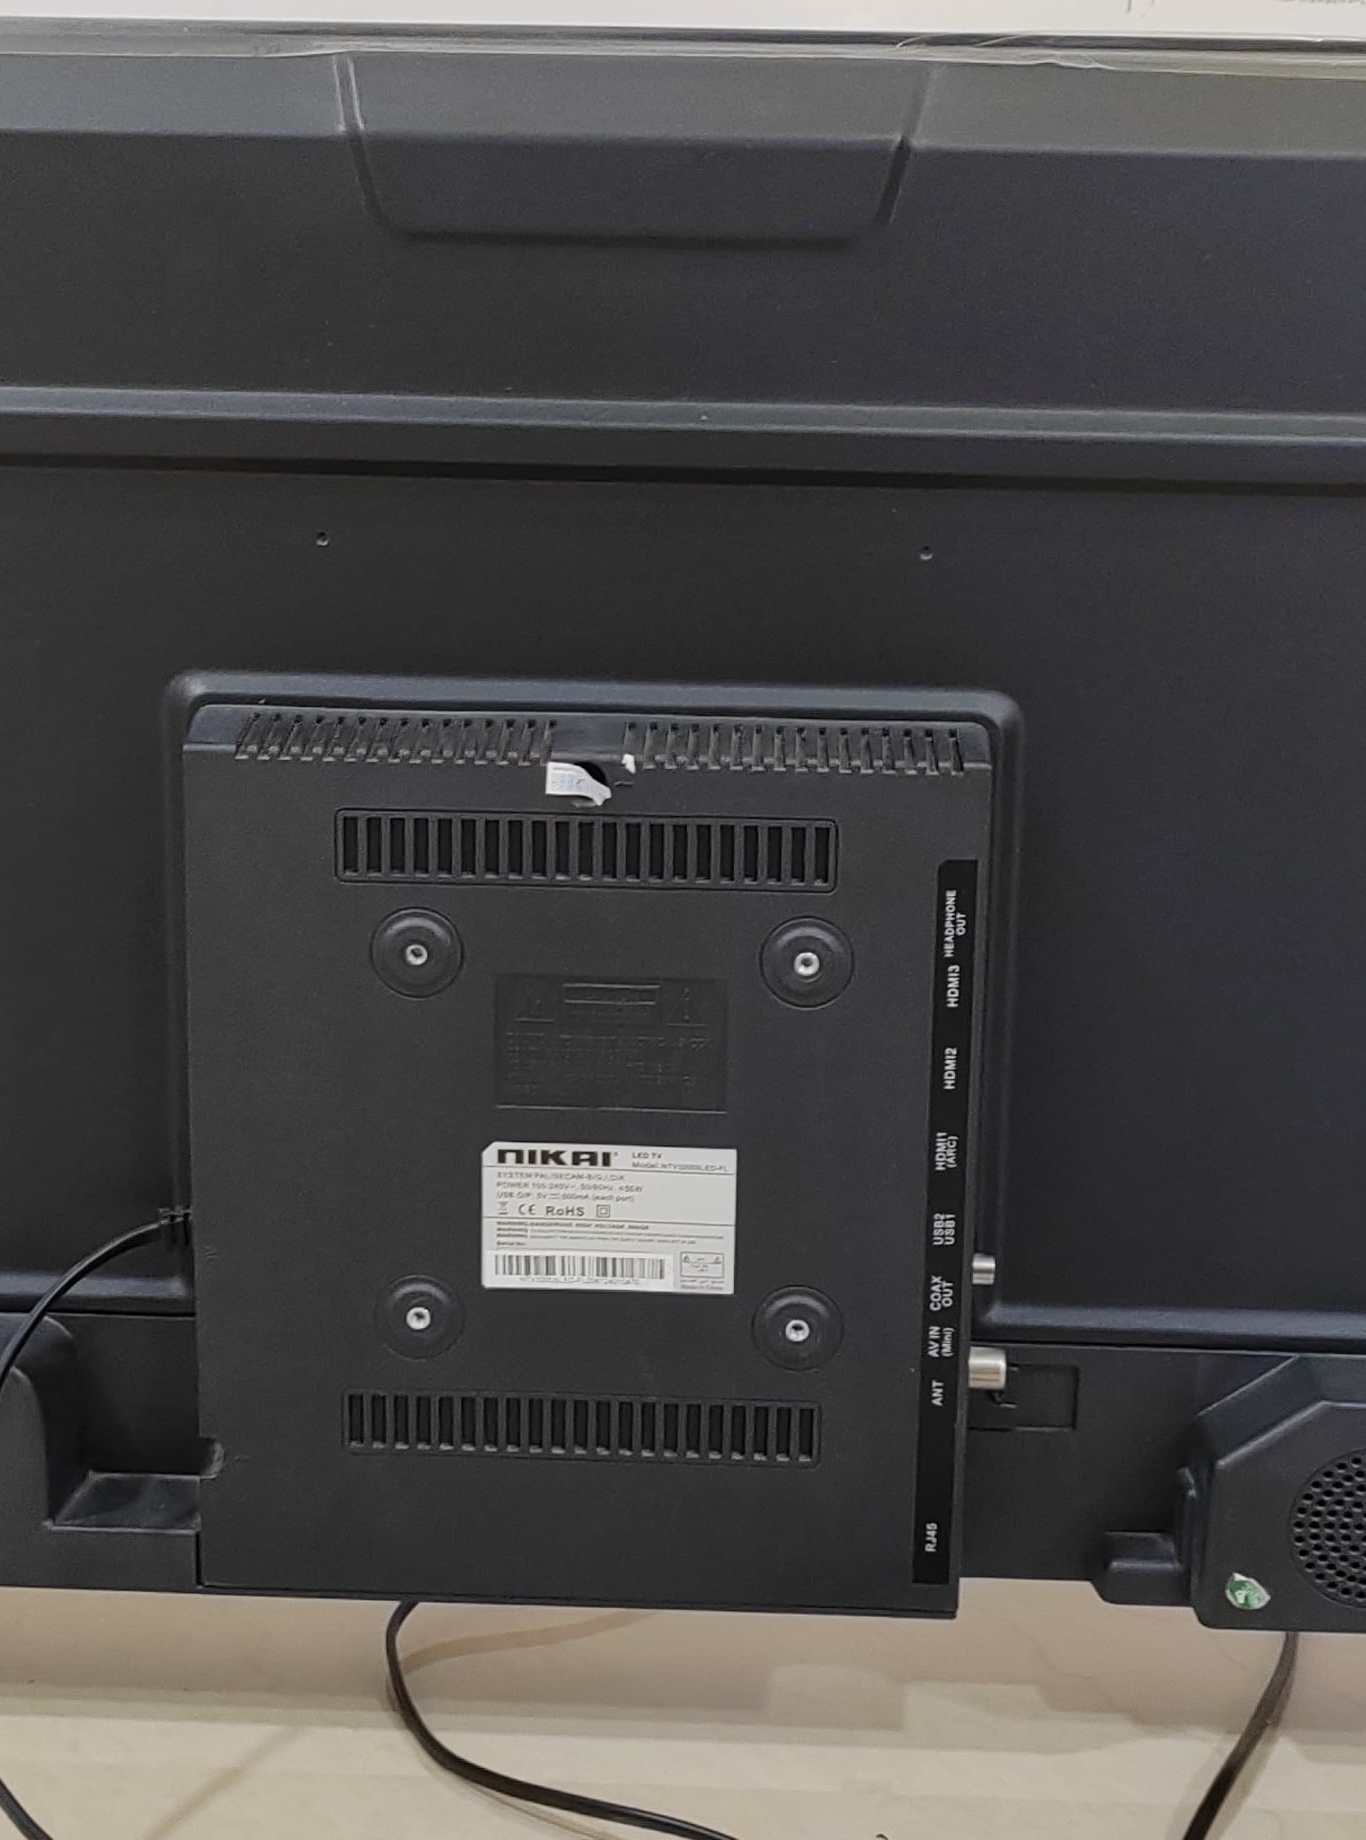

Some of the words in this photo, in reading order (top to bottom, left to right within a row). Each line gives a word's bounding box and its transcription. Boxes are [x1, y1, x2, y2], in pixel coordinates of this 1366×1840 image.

[944, 890, 957, 957] HEADPHONE
[956, 912, 966, 936] OUT
[947, 964, 960, 1007] HDMI3
[943, 1047, 957, 1089] HDMI2
[935, 1132, 947, 1171] HDMI1
[947, 1135, 958, 1168] (ARC)
[545, 1205, 585, 1217] RoHS
[933, 1213, 945, 1245] USB2
[945, 1213, 956, 1245] USB1
[930, 1275, 942, 1311] COAX
[942, 1280, 954, 1307] OUT
[929, 1326, 941, 1338] IN
[942, 1327, 955, 1357] (Mini)
[928, 1341, 940, 1357] AV
[931, 1380, 944, 1406] ANT
[925, 1523, 938, 1552] RJ45
